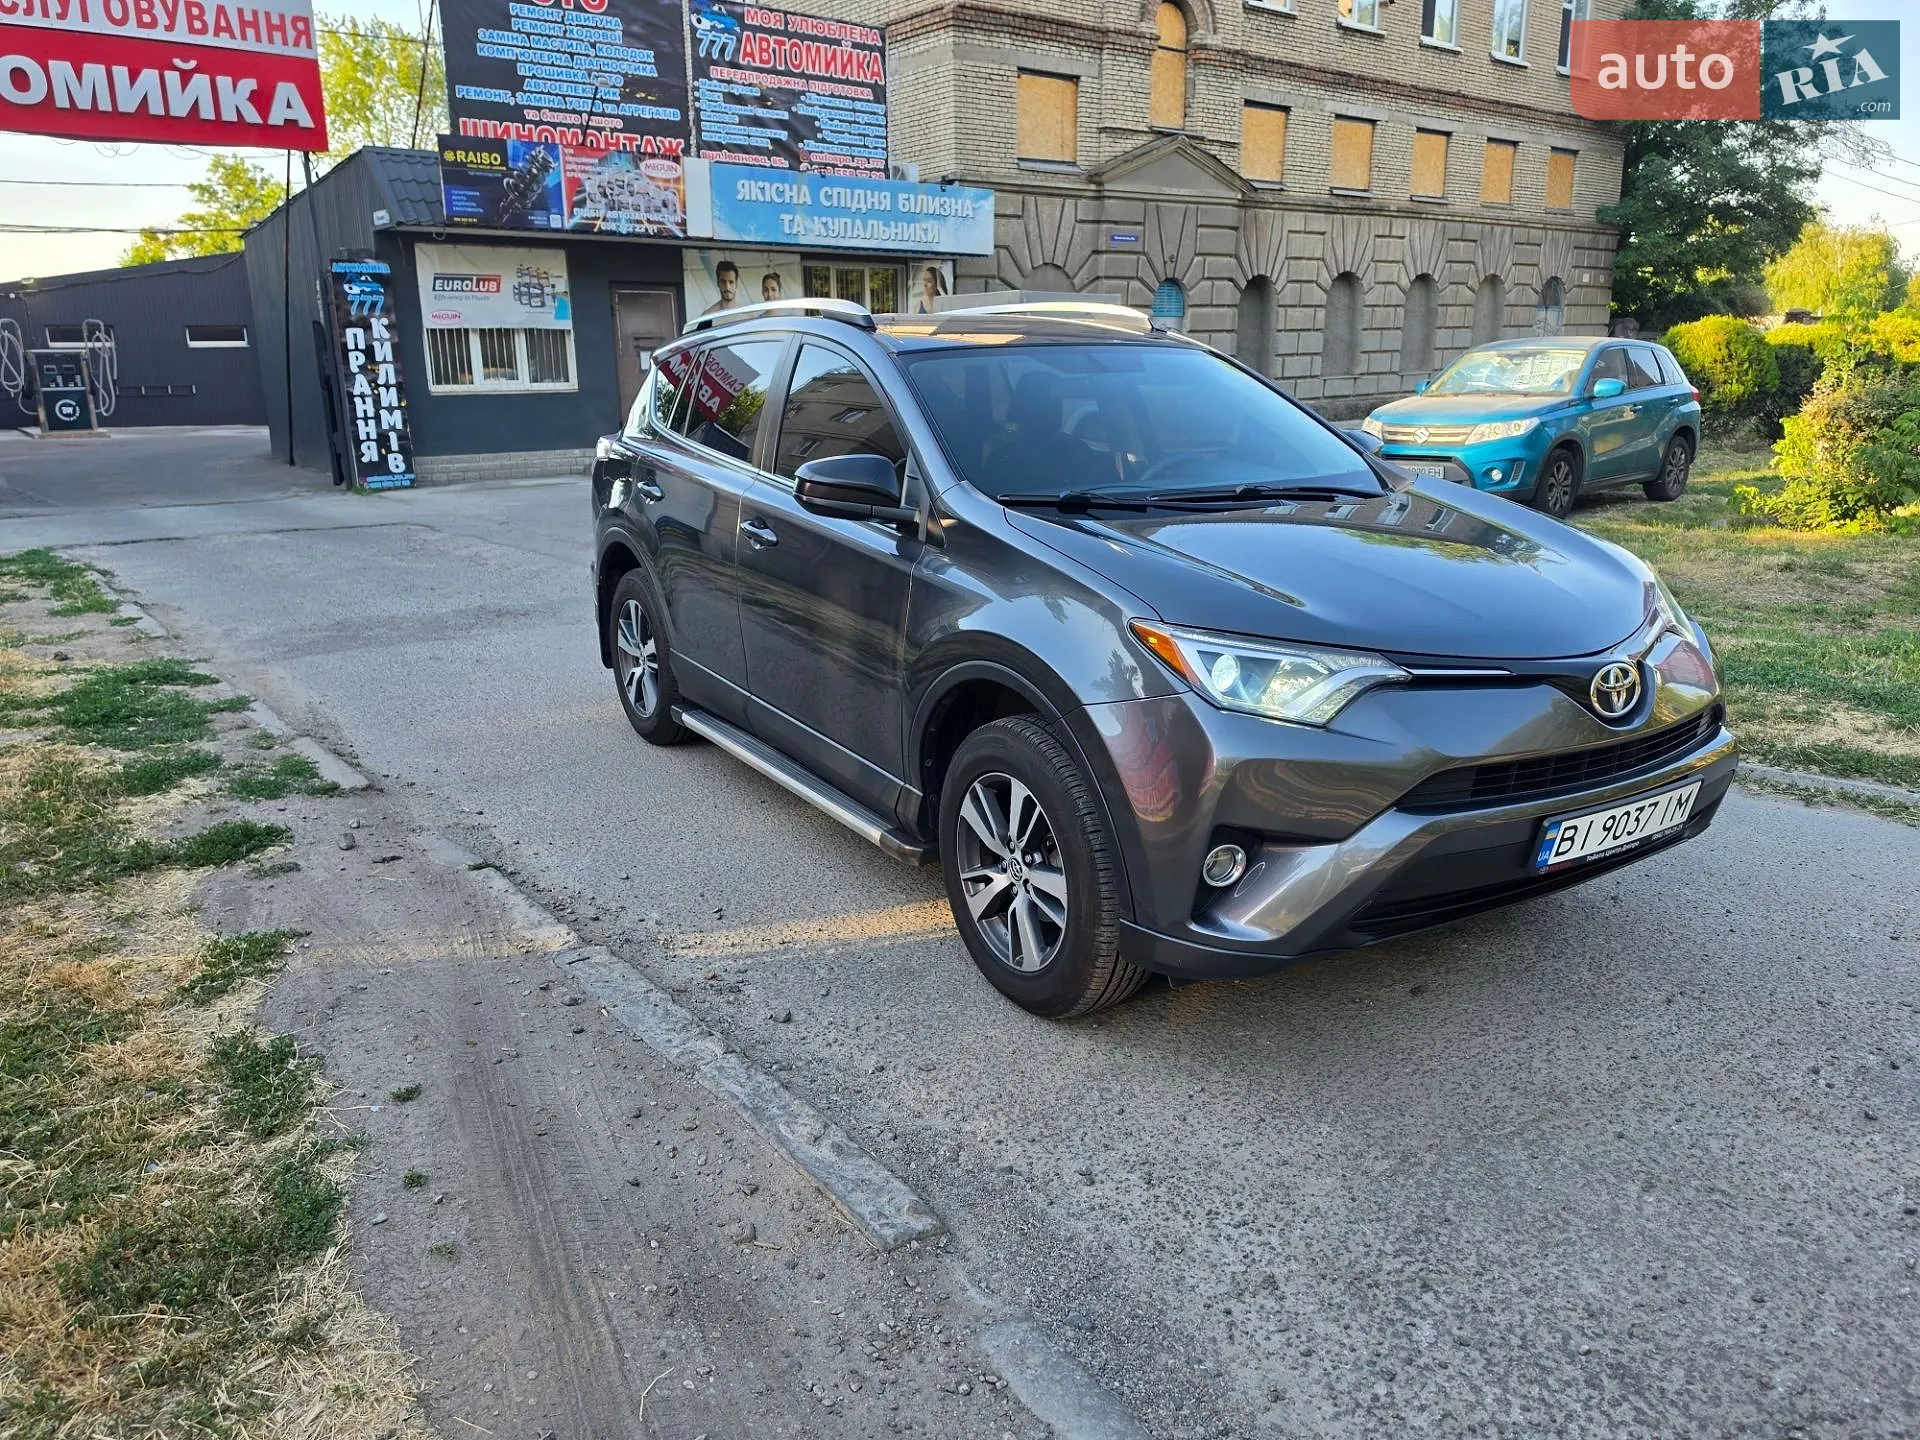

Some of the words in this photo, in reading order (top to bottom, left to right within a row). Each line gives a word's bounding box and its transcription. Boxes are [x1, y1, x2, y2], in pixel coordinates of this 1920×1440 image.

[509, 3, 563, 20] РЕМОНТ
[565, 11, 622, 30] ДВИГУНА
[511, 18, 564, 36] РЕМОНТ
[744, 7, 784, 30] МОЯ
[788, 14, 882, 46] УЛЮБЛЕНА
[478, 28, 530, 47] ЗАМІНА
[530, 35, 595, 56] МАСТИЛА,
[596, 43, 655, 63] КОЛОДОК
[696, 30, 736, 61] 777
[740, 32, 885, 84] АВТОМИЙКА
[517, 63, 589, 83] ПРОШИВКА
[591, 71, 624, 86] АТО
[573, 55, 658, 77] ДІАГНОСТИКА
[0, 54, 315, 129] ОМИЙКА
[710, 66, 807, 91] ПЕРЕДПРОДАЖНА
[808, 80, 874, 100] ПІДГОТОВКА
[455, 85, 515, 105] РЕМОНТ,
[516, 92, 565, 109] ЗАМІНА
[565, 97, 603, 112] УЗЛВ
[604, 104, 617, 114] та
[619, 103, 681, 121] АГРЕГАТІВ
[524, 109, 539, 121] та
[541, 109, 580, 124] багато
[459, 117, 684, 157] ШИНОМОНТАЖ
[456, 150, 501, 165] RAISO
[736, 179, 812, 205] ЯКІСНА
[820, 186, 892, 213] СПІДНЯ
[898, 193, 974, 219] БІЛИЗНА
[780, 213, 806, 236] ТА
[814, 216, 941, 243] КУПАЛЬНИКИ
[434, 276, 498, 291] EUROLUB
[347, 294, 384, 316] 777
[345, 327, 379, 463] ПРАННЯ
[370, 317, 406, 473] КИЛИМІВ
[1553, 820, 1594, 858] BI
[1597, 801, 1659, 846] 9037
[1660, 789, 1694, 826] IM
[1537, 852, 1550, 862] UA
